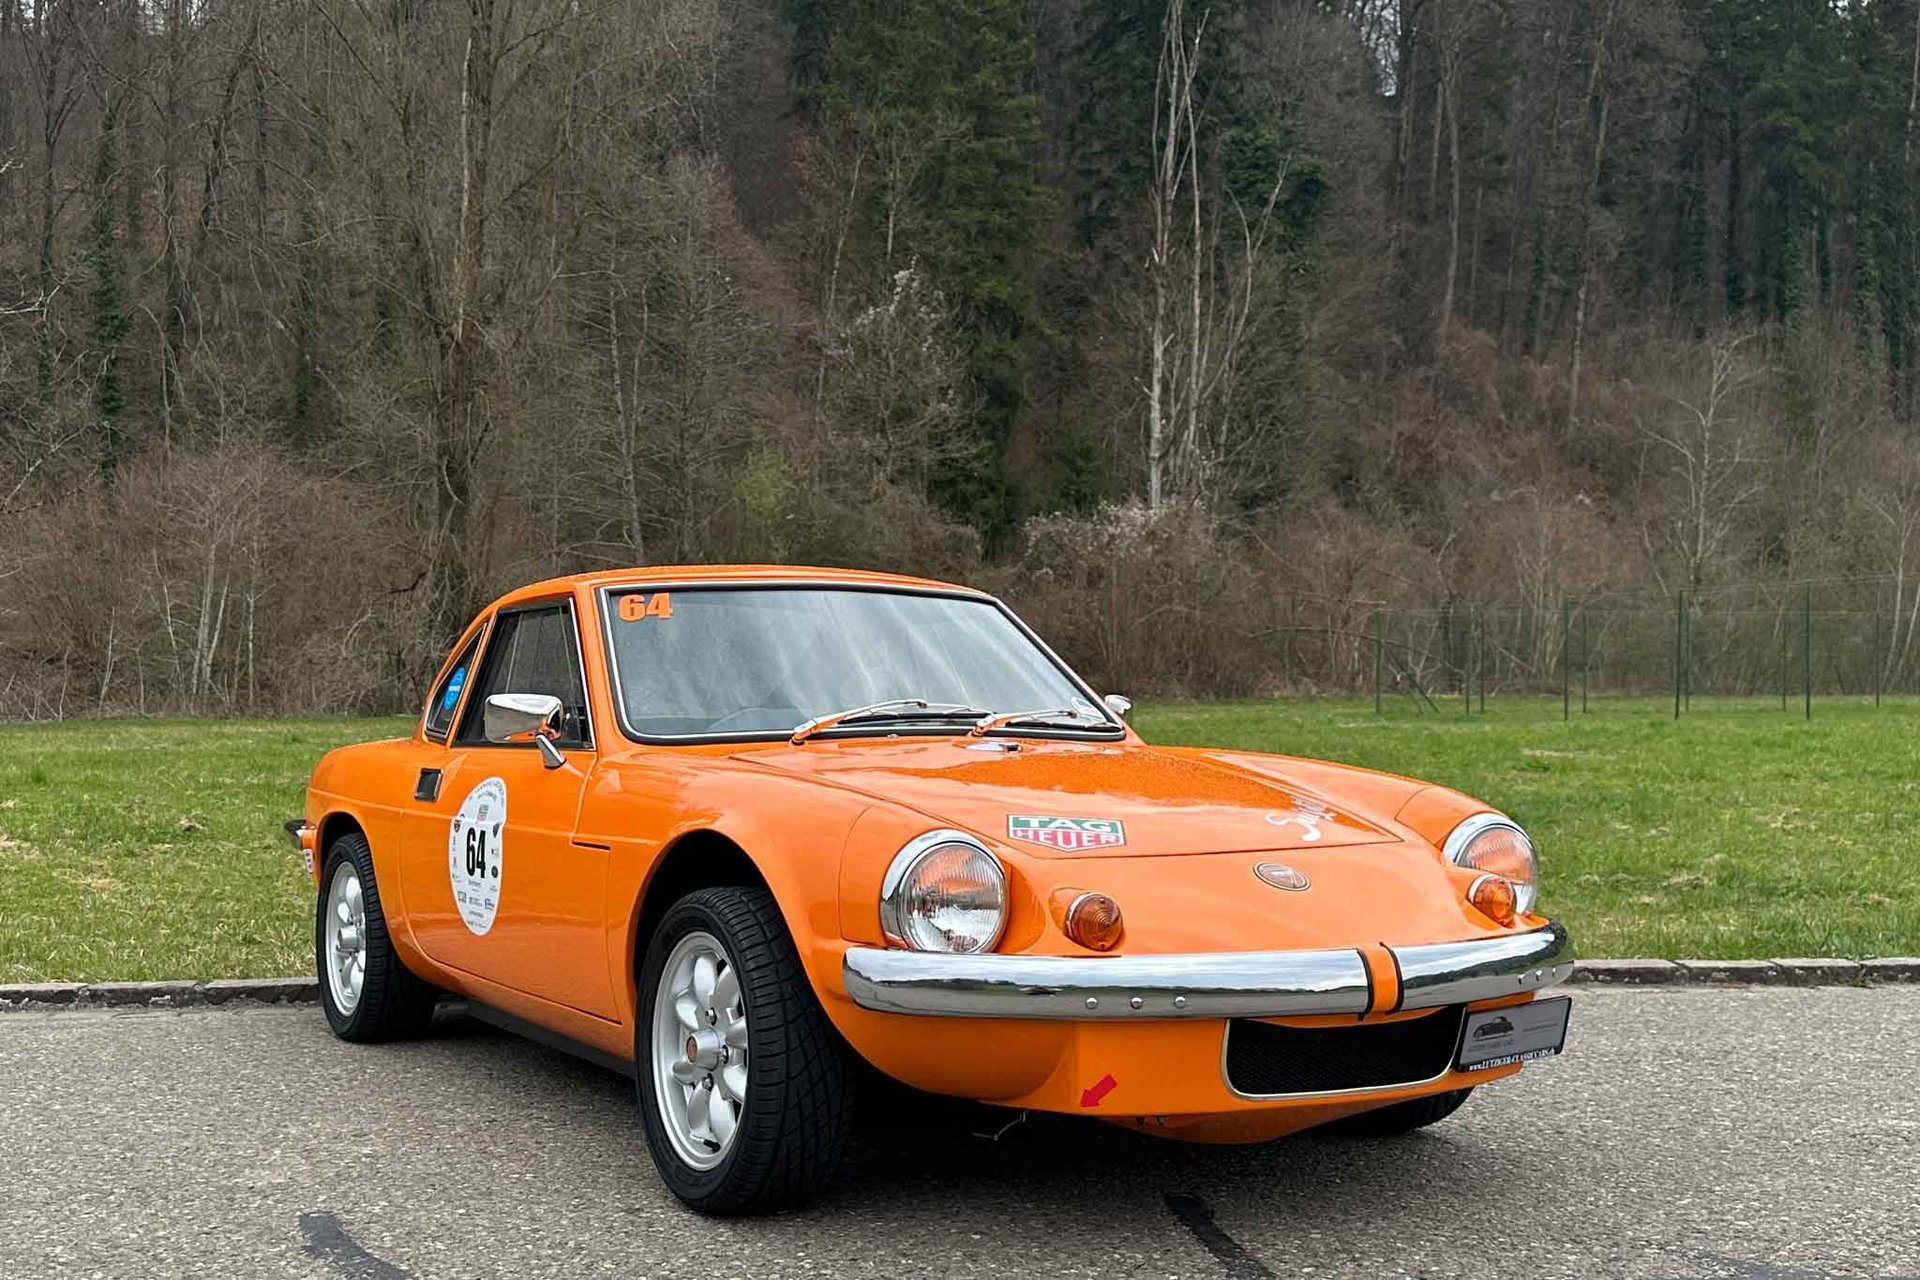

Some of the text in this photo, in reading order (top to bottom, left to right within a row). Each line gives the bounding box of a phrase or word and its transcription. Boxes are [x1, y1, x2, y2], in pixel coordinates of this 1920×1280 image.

[619, 593, 673, 621] 64
[1018, 817, 1112, 833] TAG
[1014, 829, 1120, 849] HEUER
[466, 827, 486, 879] 64
